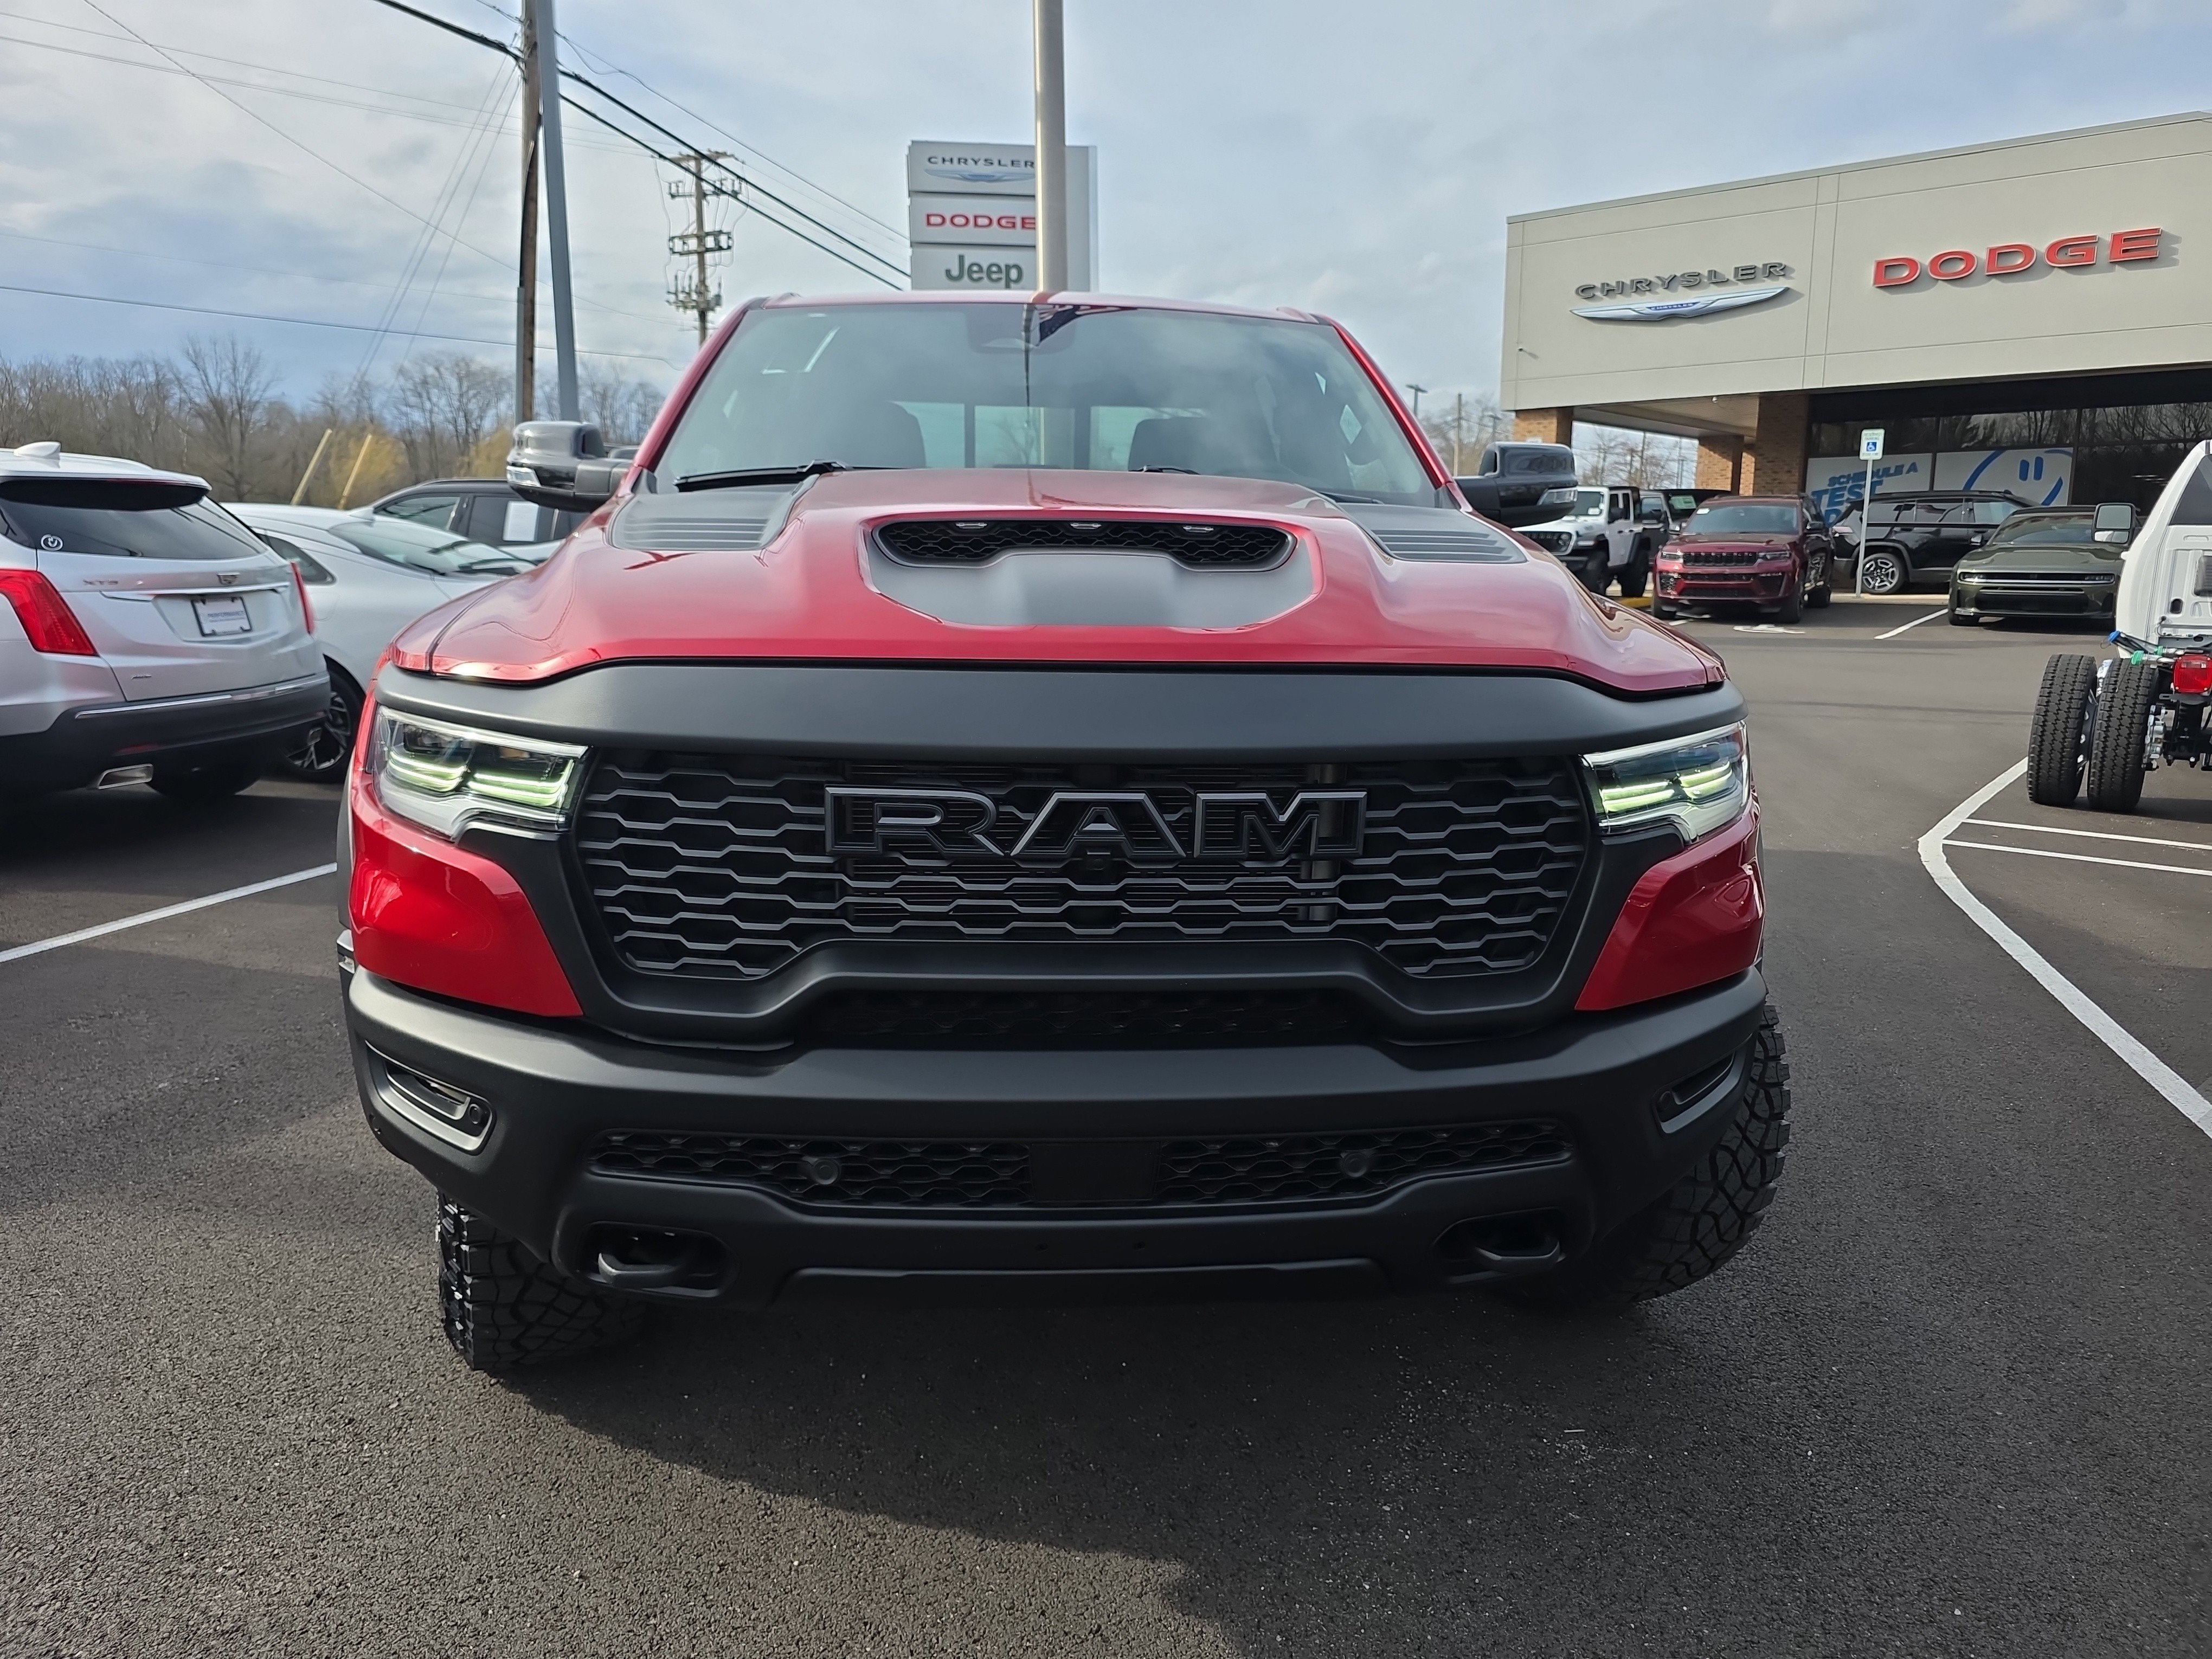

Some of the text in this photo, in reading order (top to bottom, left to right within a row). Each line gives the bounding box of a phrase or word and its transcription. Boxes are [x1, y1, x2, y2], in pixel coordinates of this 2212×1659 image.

[928, 156, 1034, 169] CHRYSLER
[926, 214, 1036, 230] DODGE
[945, 254, 1023, 288] Jeep
[1872, 228, 2162, 287] DODGE
[1575, 262, 1786, 299] CHRYSLER
[1905, 462, 1919, 474] A
[1811, 479, 1883, 509] TEST
[824, 785, 1368, 858] RAM
